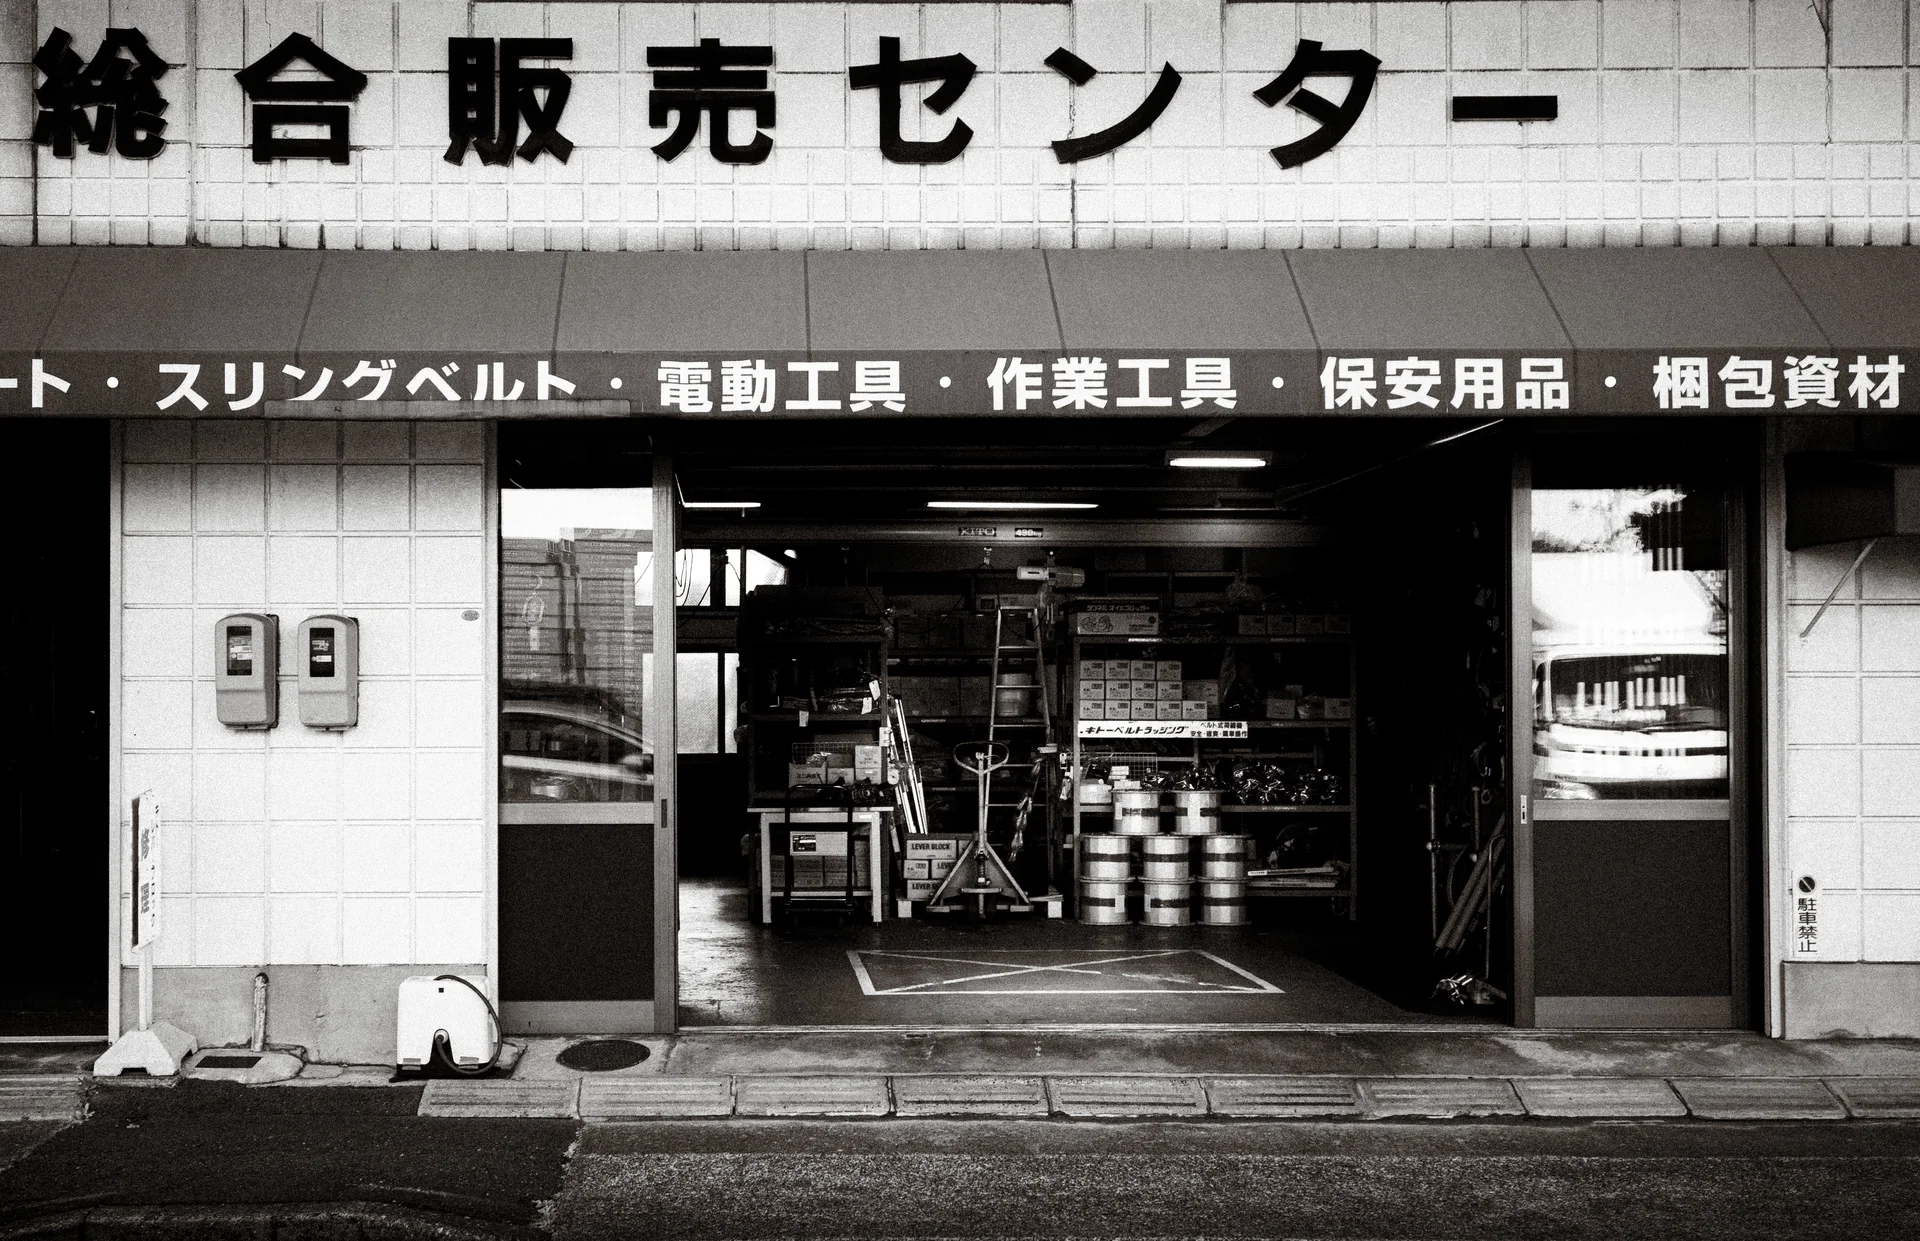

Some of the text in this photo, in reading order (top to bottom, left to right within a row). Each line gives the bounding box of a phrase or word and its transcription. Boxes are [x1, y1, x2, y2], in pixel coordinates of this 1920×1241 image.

[33, 26, 1558, 170] 総合販売センター
[156, 358, 577, 411] スリングベルト
[656, 359, 906, 413] 電動工具
[986, 356, 1238, 411] 作業工具
[1319, 355, 1570, 410] 保安用品
[1652, 354, 1905, 410] 梱包資材
[960, 527, 995, 536] KITO
[1797, 897, 1818, 953] 駐車禁止
